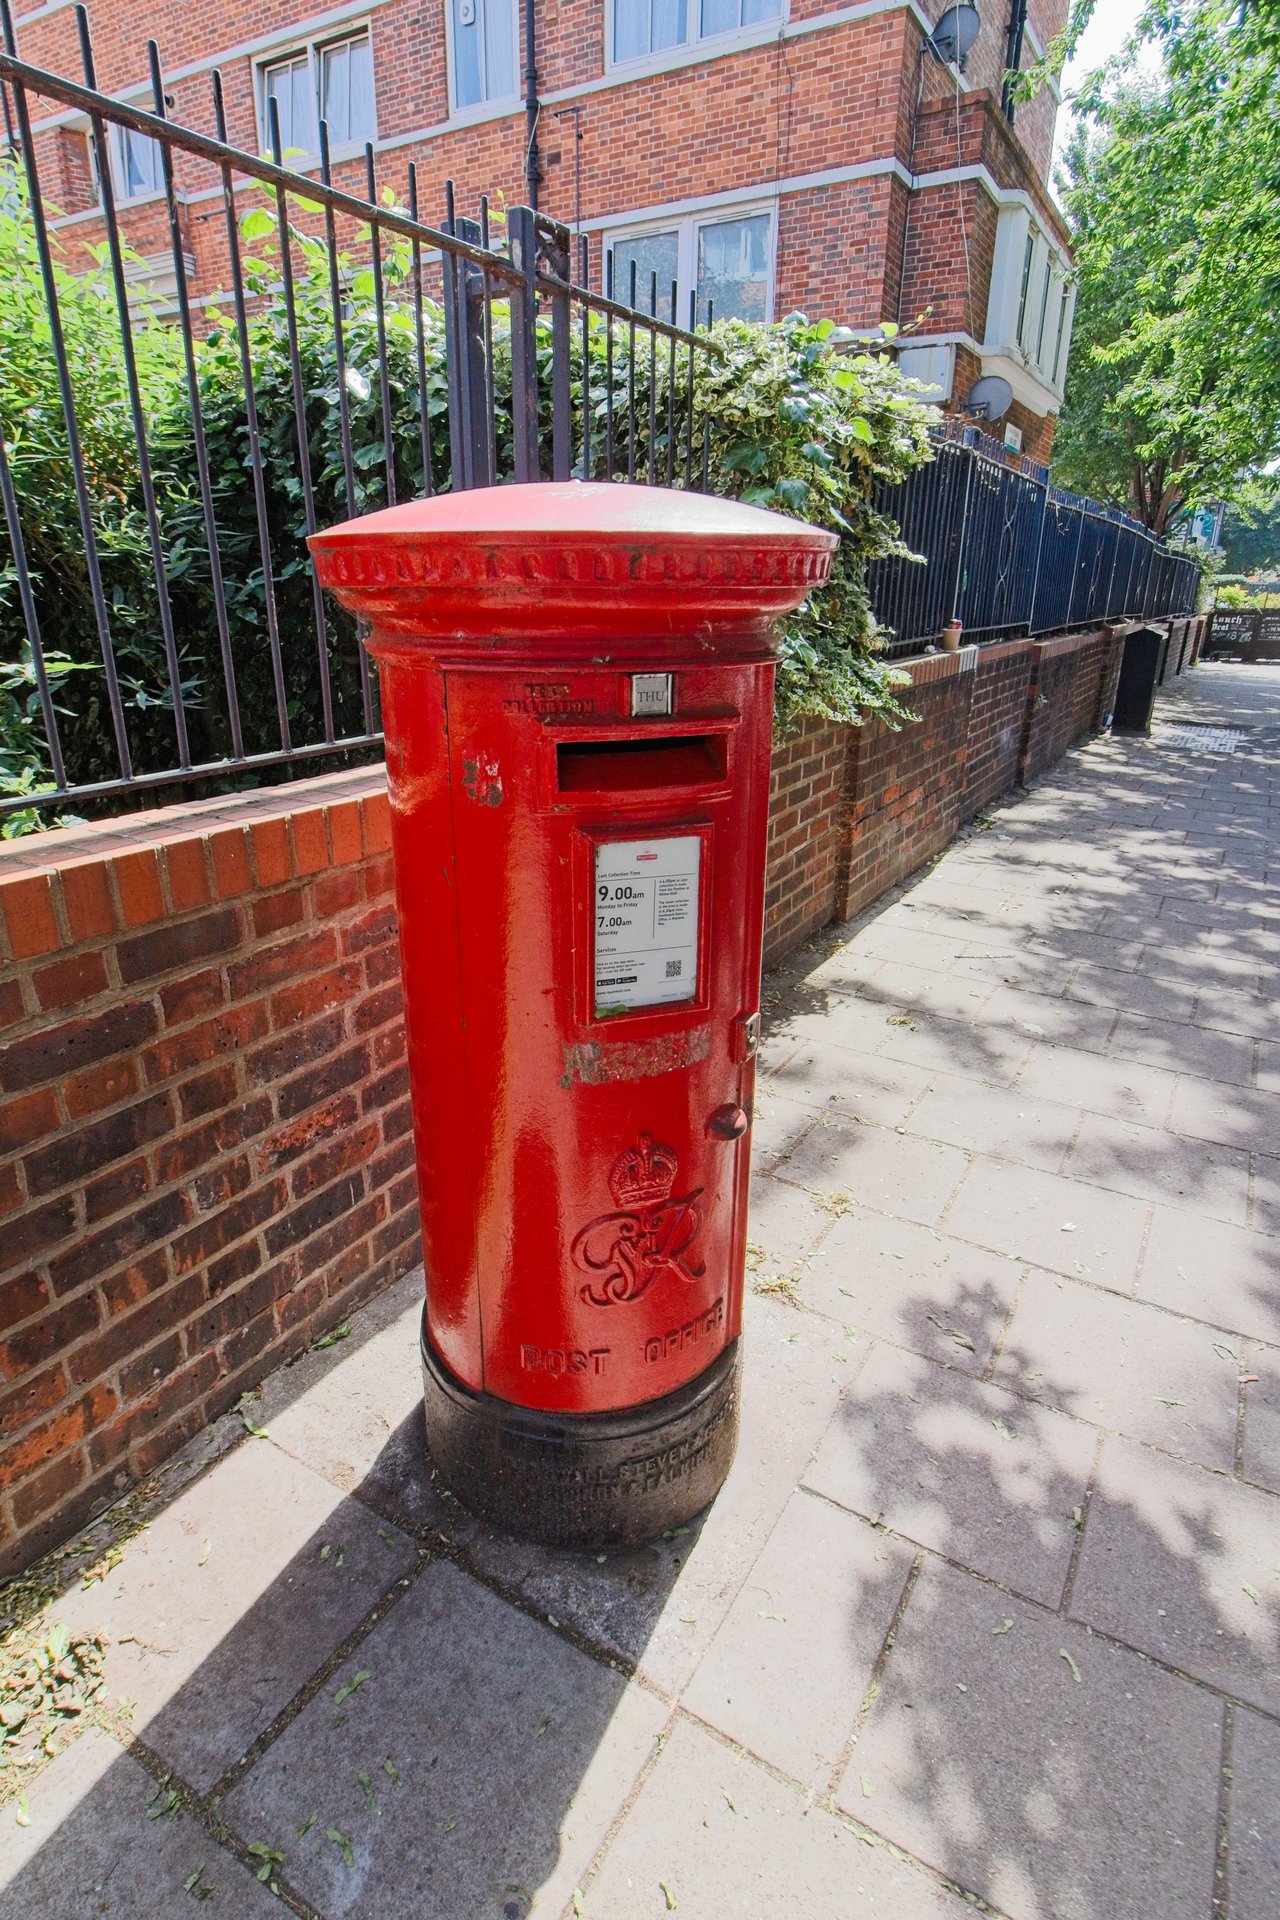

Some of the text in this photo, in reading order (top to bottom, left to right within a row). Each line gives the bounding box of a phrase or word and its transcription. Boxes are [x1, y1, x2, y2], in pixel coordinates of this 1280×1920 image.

[1212, 614, 1243, 625] Lunch
[637, 691, 665, 702] THU
[598, 885, 644, 901] 9.00am
[597, 916, 632, 928] 7.00am
[520, 1343, 611, 1376] POST
